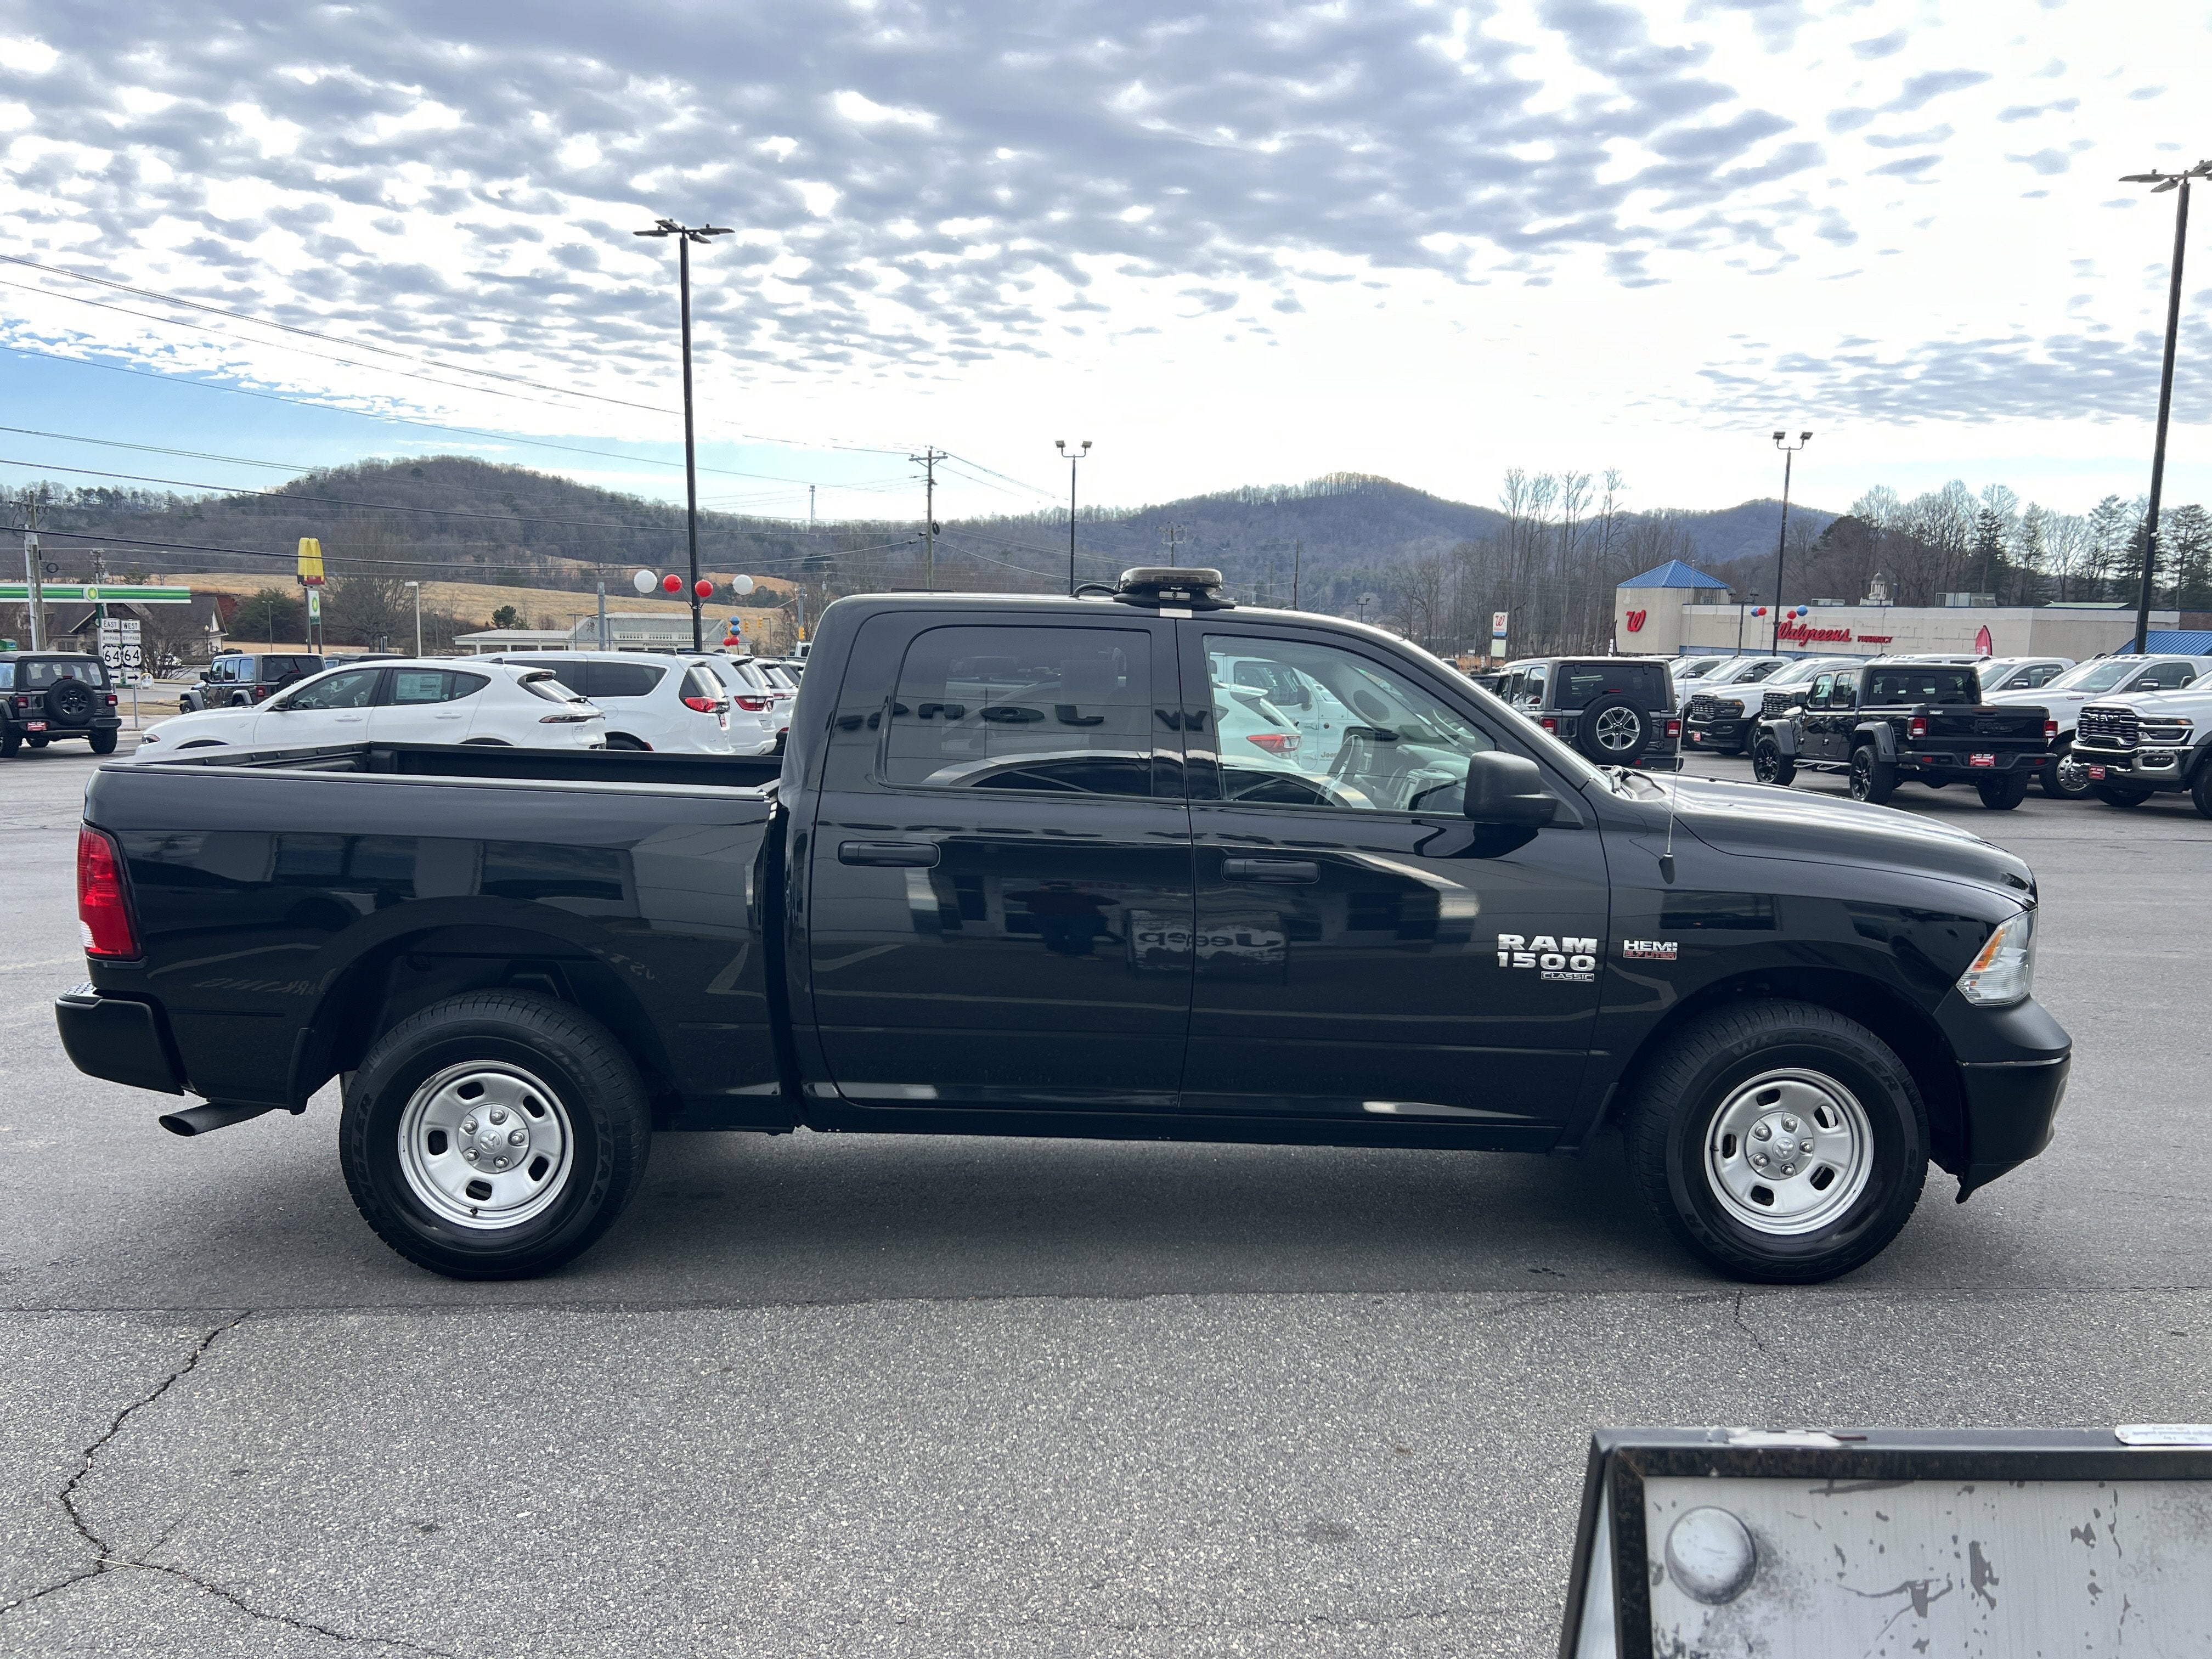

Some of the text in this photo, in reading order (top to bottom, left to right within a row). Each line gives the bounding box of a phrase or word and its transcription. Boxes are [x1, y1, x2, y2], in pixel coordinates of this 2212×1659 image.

[1777, 620, 1853, 647] Walgreens
[104, 650, 120, 663] 64
[124, 649, 140, 662] 64
[1498, 933, 1598, 954] RAM
[1623, 940, 1678, 951] HEMI
[1497, 951, 1596, 972] 1500
[1542, 972, 1593, 981] CLASSIC
[530, 1035, 614, 1207] GOODYEAR
